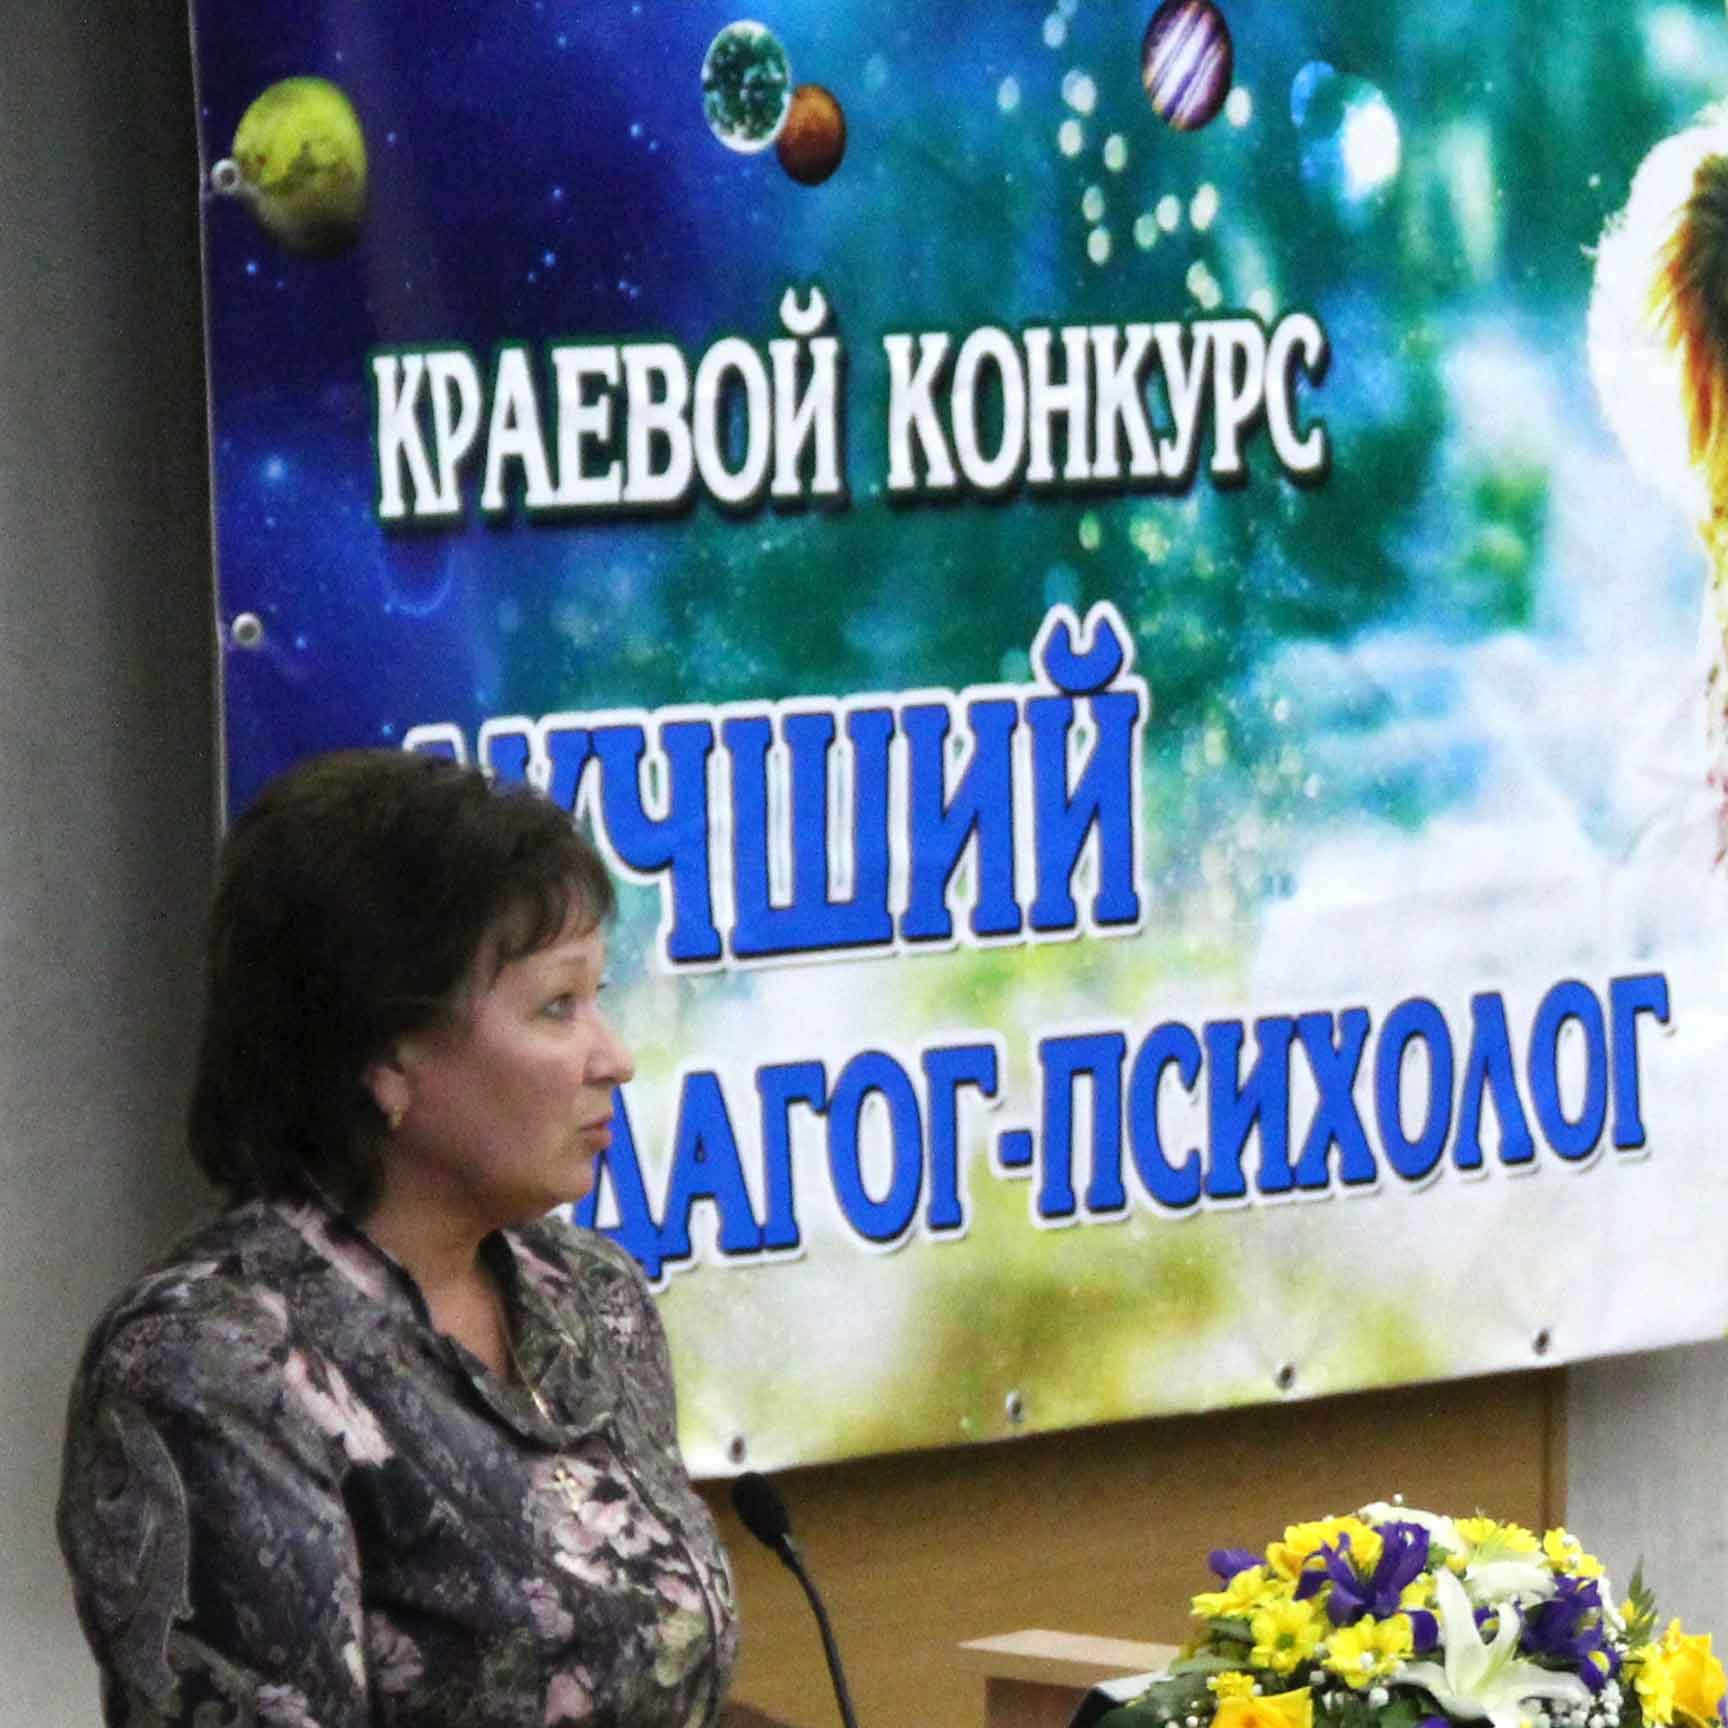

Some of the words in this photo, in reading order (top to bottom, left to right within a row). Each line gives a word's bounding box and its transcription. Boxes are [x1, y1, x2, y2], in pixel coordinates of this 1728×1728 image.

[372, 285, 842, 519] КРАЕВОЙ
[882, 312, 1326, 491] КОНКУРС
[412, 616, 1141, 964] ЧШИЙ
[574, 971, 1671, 1282] ДАГОГ-ПСИХОЛОГ
